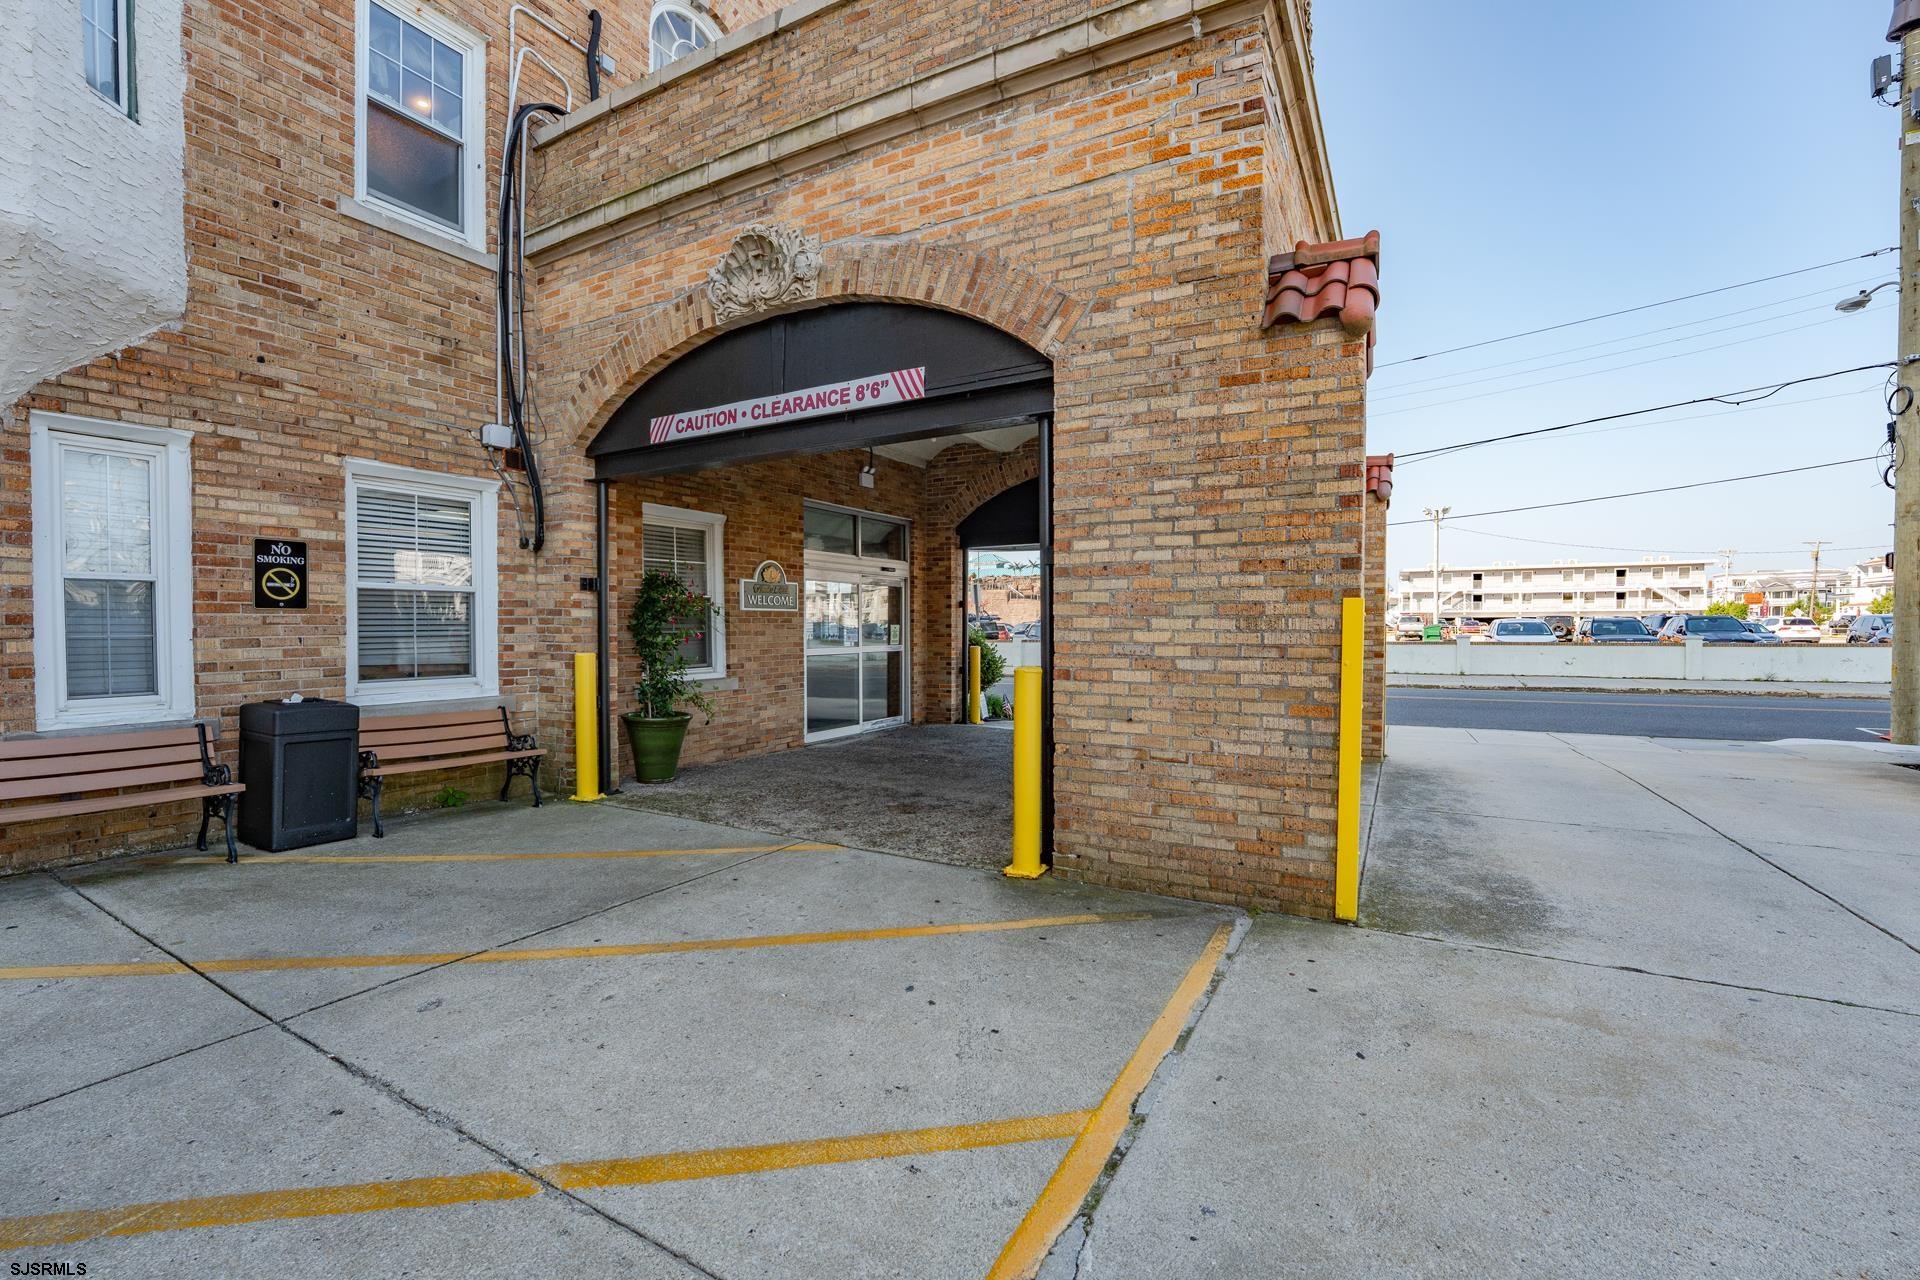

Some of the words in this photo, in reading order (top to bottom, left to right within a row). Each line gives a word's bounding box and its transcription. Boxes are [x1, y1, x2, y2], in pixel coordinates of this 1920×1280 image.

[675, 408, 738, 434] CAUTION
[750, 386, 851, 421] CLEARANCE
[271, 544, 292, 556] NO
[256, 555, 305, 565] SMOKING
[747, 594, 794, 606] WELCOME
